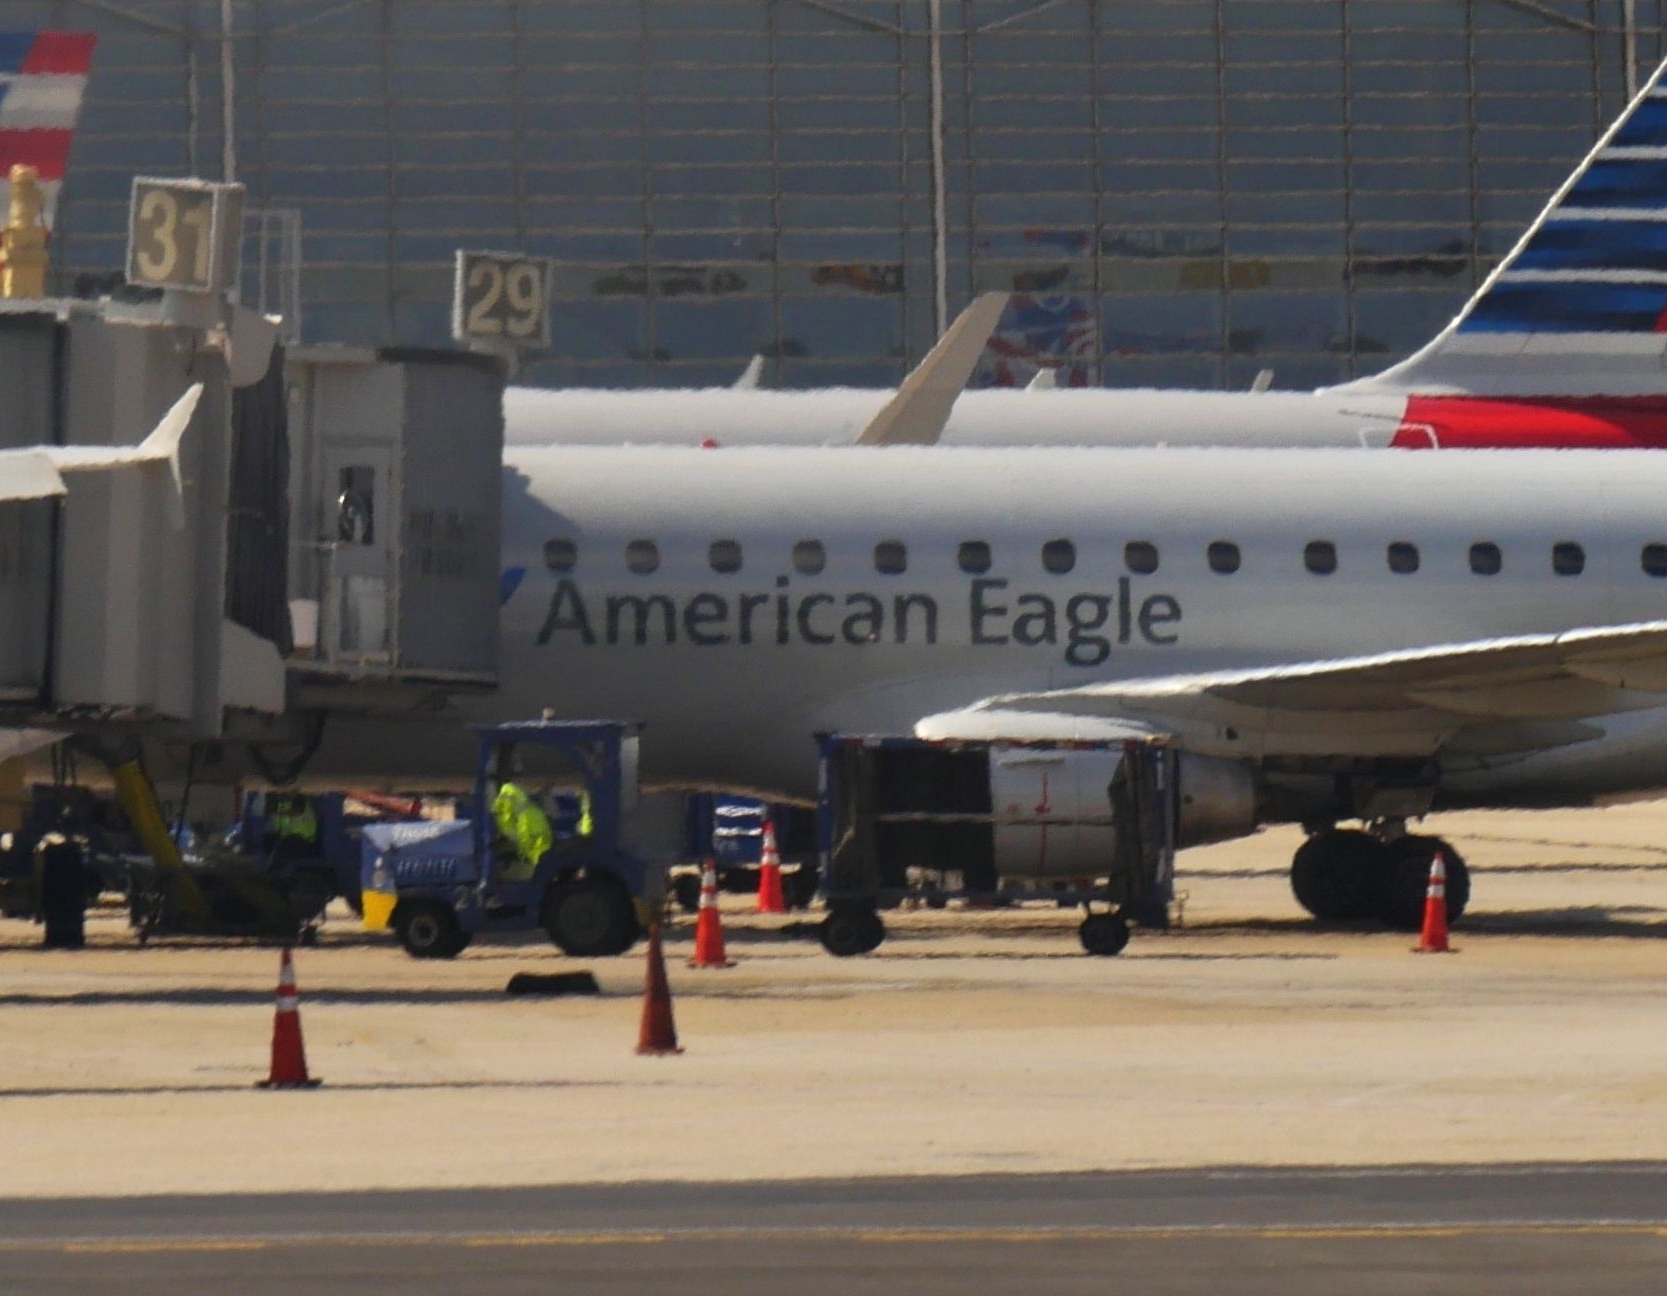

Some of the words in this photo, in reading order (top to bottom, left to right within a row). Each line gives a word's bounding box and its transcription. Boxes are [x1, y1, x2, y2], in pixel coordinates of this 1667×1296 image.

[138, 191, 211, 283] 31
[468, 262, 541, 336] 29
[535, 576, 939, 647] American
[969, 575, 1183, 667] Eagle
